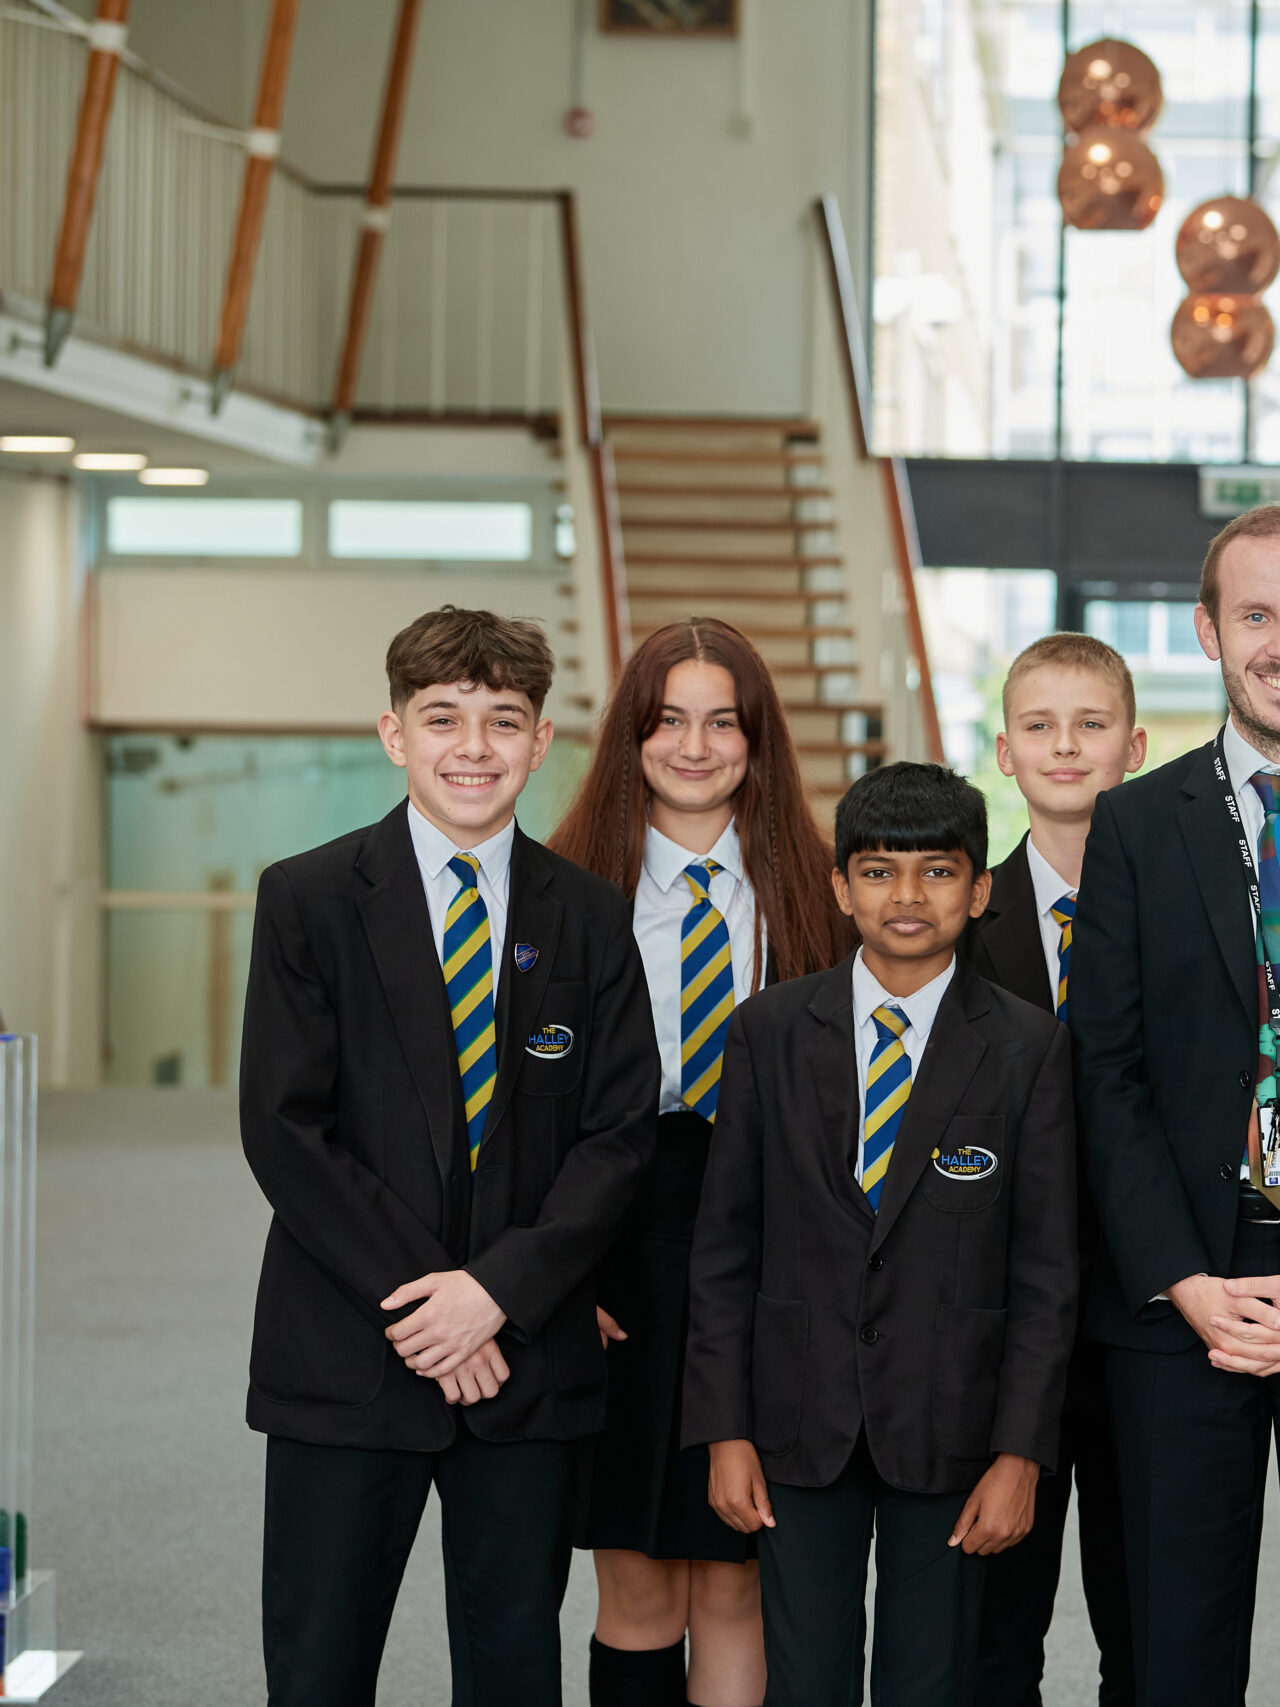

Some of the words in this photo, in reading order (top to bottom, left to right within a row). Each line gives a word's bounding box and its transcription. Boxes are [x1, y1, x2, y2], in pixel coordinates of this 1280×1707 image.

[1213, 757, 1227, 781] STAFF
[1225, 795, 1240, 823] STAFF
[1239, 839, 1253, 868] STAFF
[1265, 960, 1276, 991] STAFF
[528, 1034, 570, 1045] HALLEY
[941, 1155, 990, 1166] HALLEY
